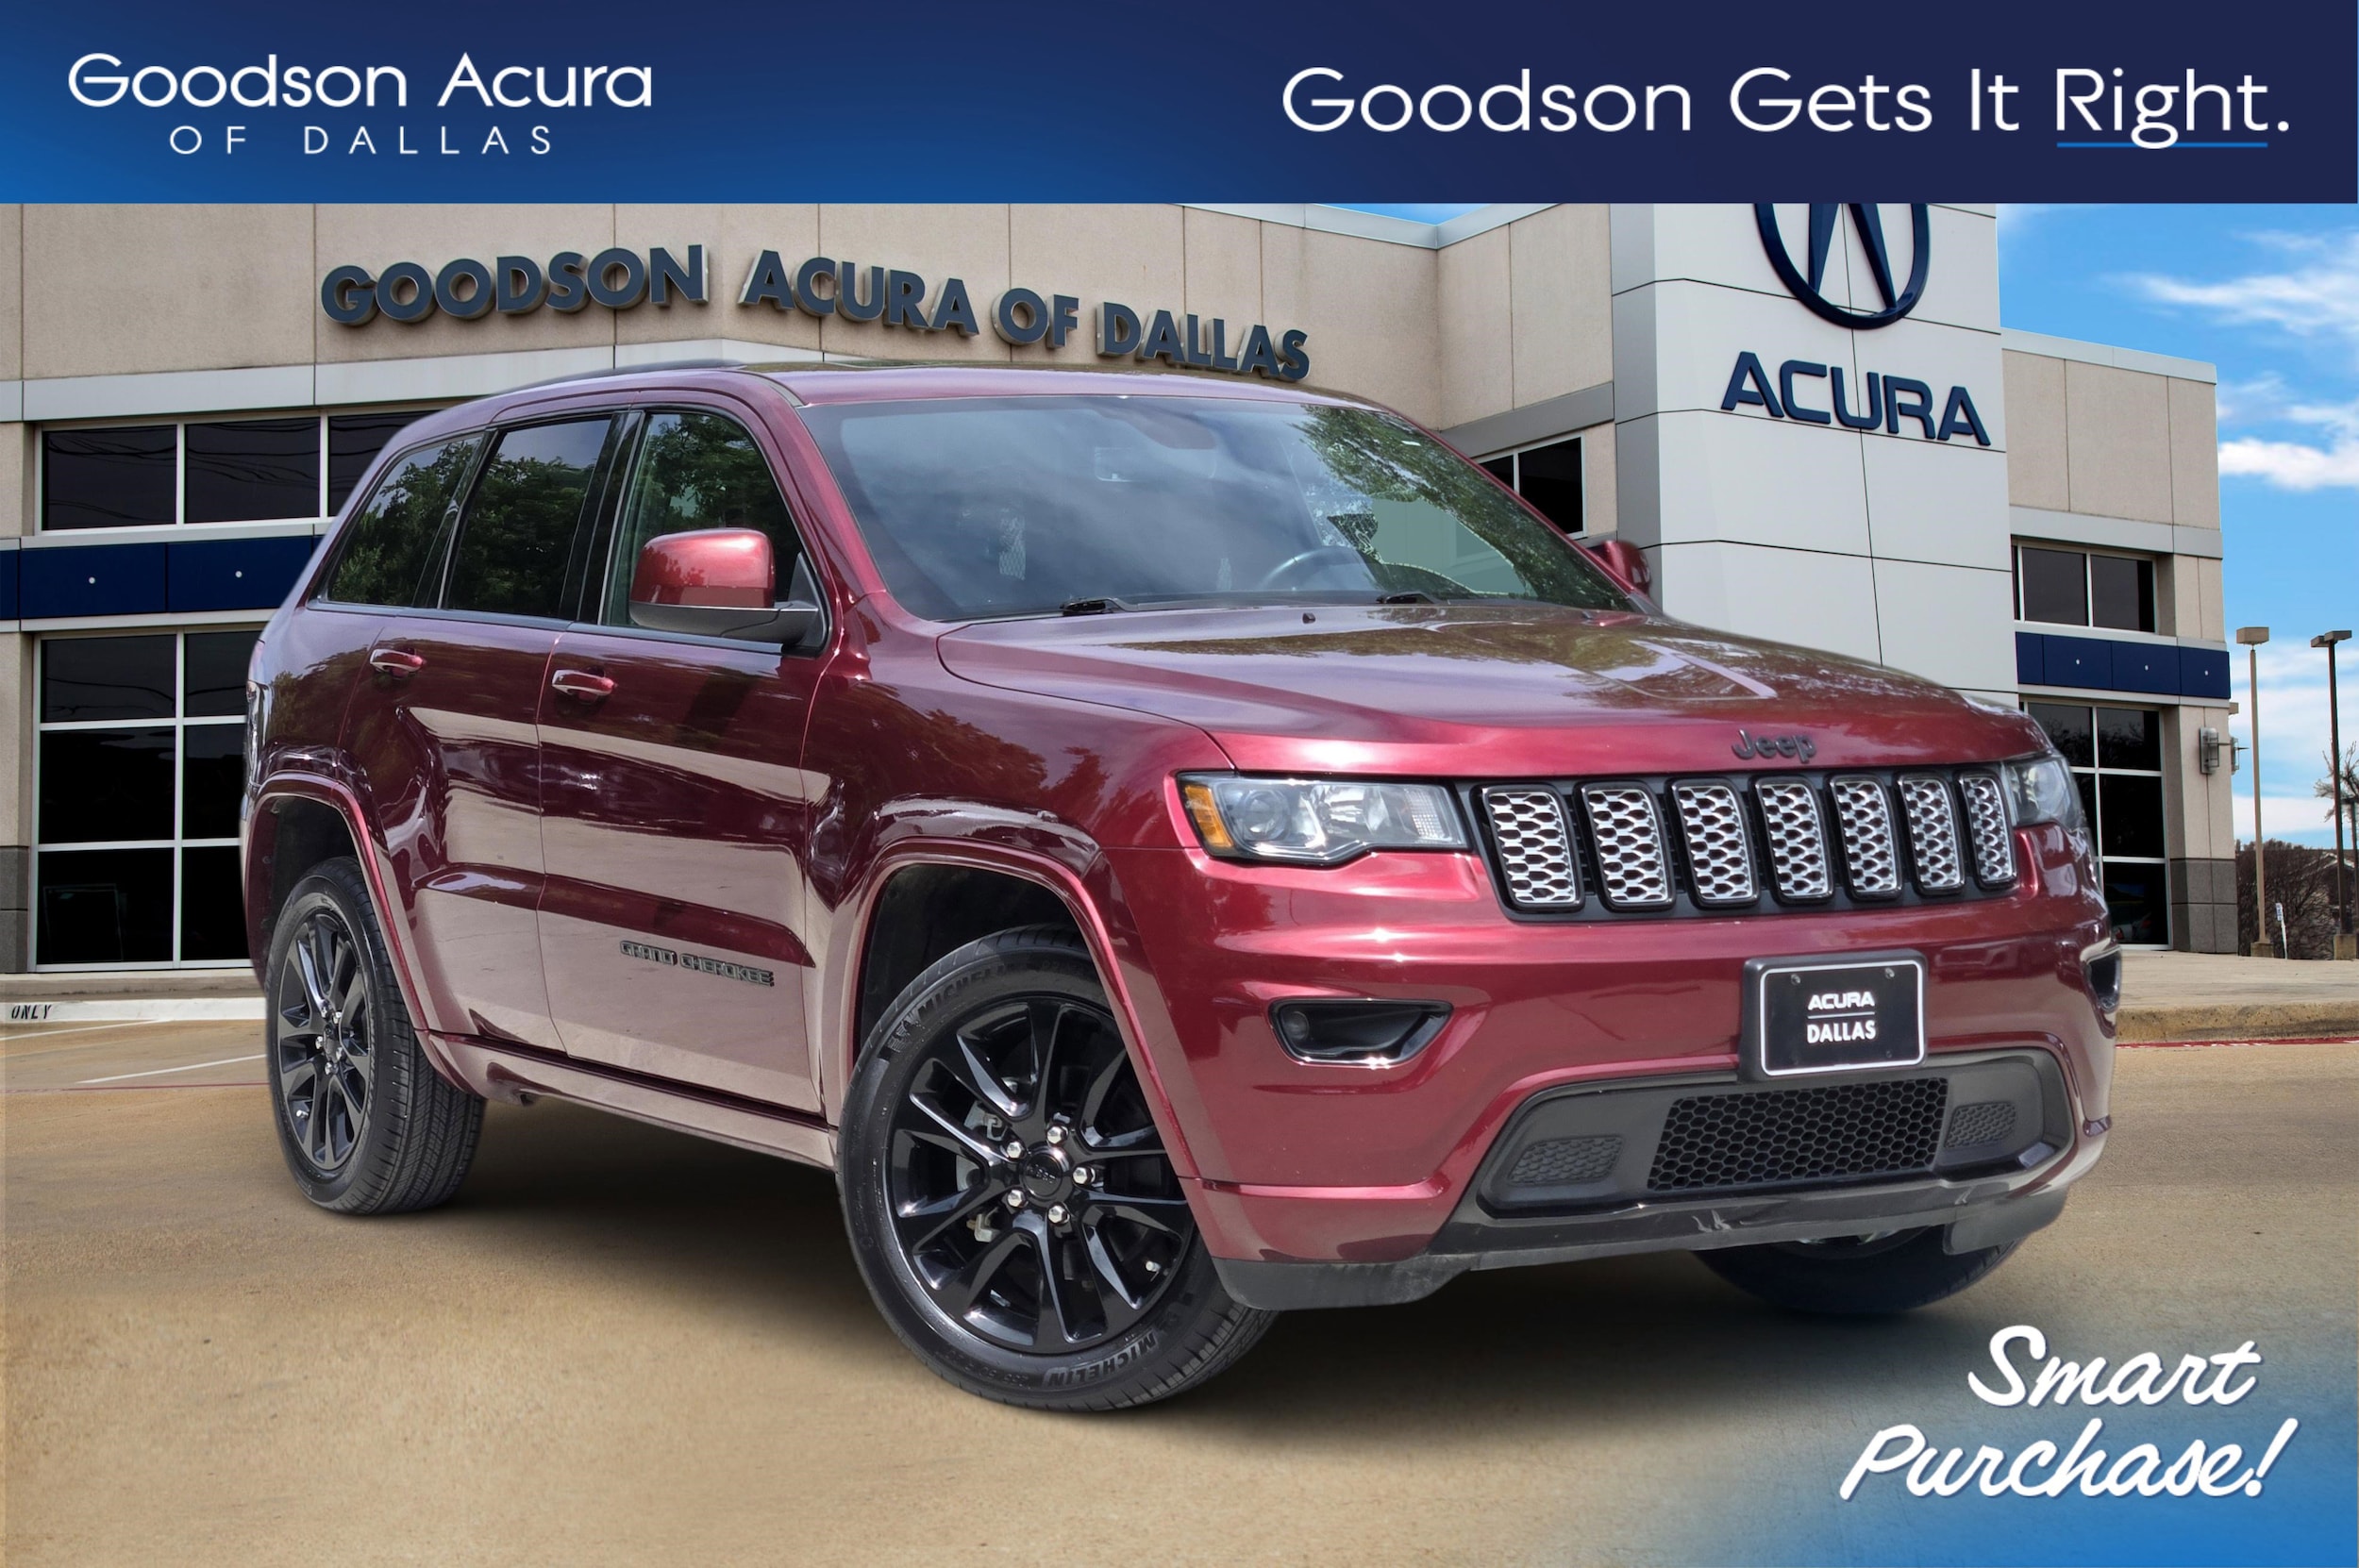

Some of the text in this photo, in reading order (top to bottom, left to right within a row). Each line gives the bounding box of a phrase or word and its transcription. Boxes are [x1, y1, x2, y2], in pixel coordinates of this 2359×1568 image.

[321, 244, 1311, 381] GOODSON ACURA OF DALLAS
[1720, 350, 1991, 446] ACURA
[1732, 728, 1817, 764] Jeep
[620, 940, 775, 987] GRAND CHEROKEE
[11, 1004, 52, 1020] ONLY
[1807, 991, 1876, 1010] ACURA
[1807, 1020, 1876, 1043] DALLAS
[1047, 1329, 1157, 1387] MICHELIN
